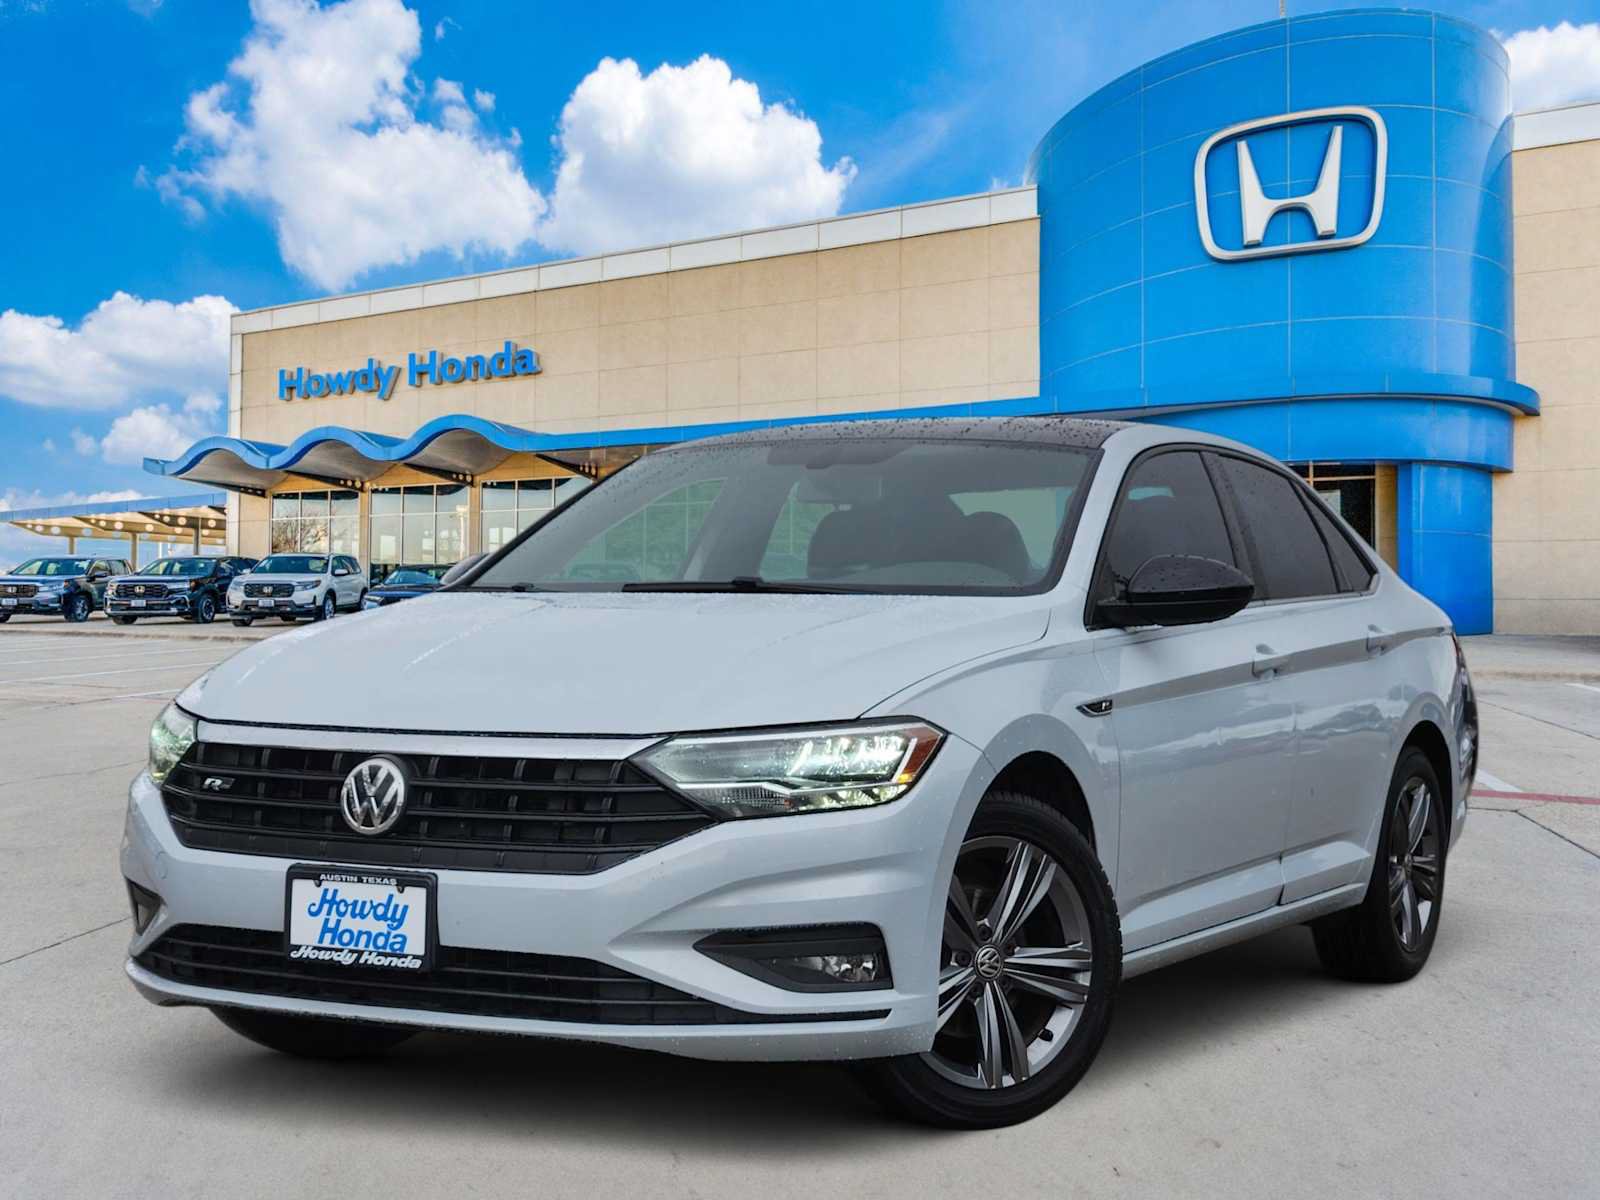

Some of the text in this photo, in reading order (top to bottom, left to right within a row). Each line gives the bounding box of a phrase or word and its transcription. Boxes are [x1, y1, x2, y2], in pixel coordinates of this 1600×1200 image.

[278, 340, 541, 400] Howdy Honda
[319, 873, 398, 886] AUSTIN TEXAS
[307, 887, 409, 931] Howdy
[317, 917, 408, 954] Honda
[290, 945, 423, 969] Howdy Honda
